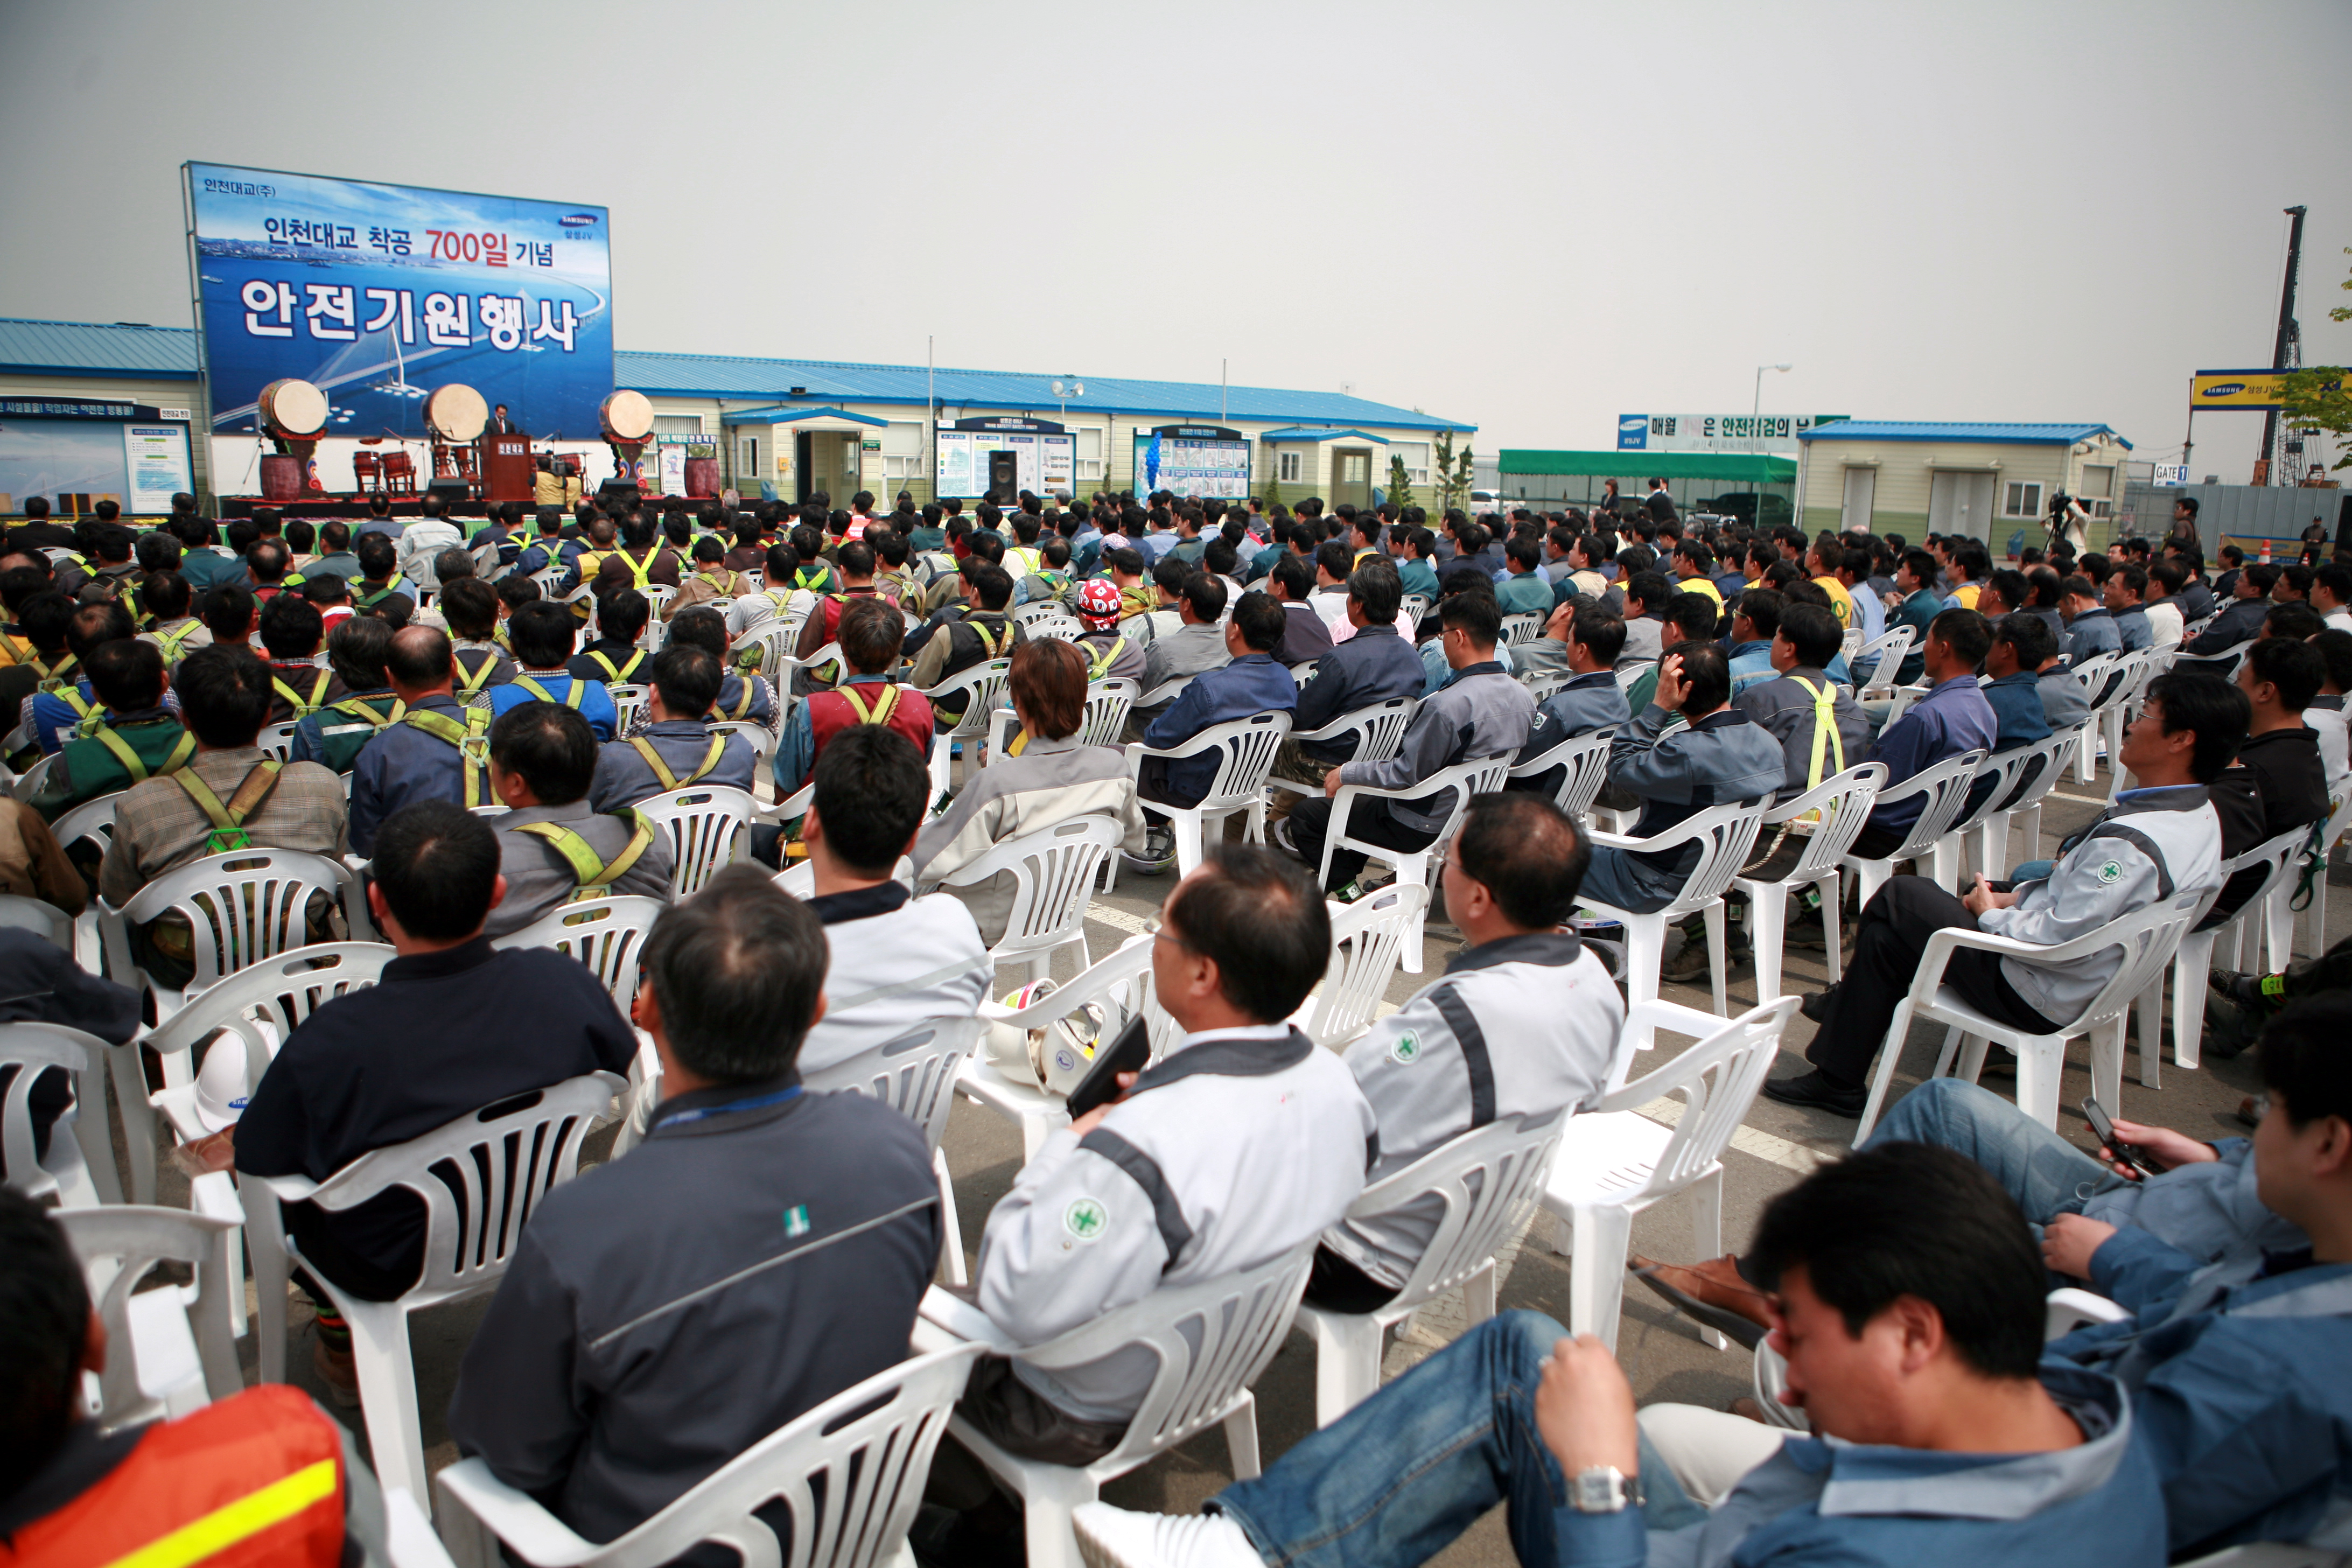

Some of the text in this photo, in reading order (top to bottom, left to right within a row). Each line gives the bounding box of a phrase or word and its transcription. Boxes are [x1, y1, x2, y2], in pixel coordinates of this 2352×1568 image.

[205, 179, 276, 198] 인천대교(주)
[562, 216, 593, 225] SAMSUNG
[264, 218, 554, 268] 인천대교 착공 700일 기념
[241, 280, 578, 352] 안전기원행사
[1651, 417, 1676, 436] 매월
[1723, 416, 1789, 438] 안전점검의
[2157, 465, 2177, 479] GATE
